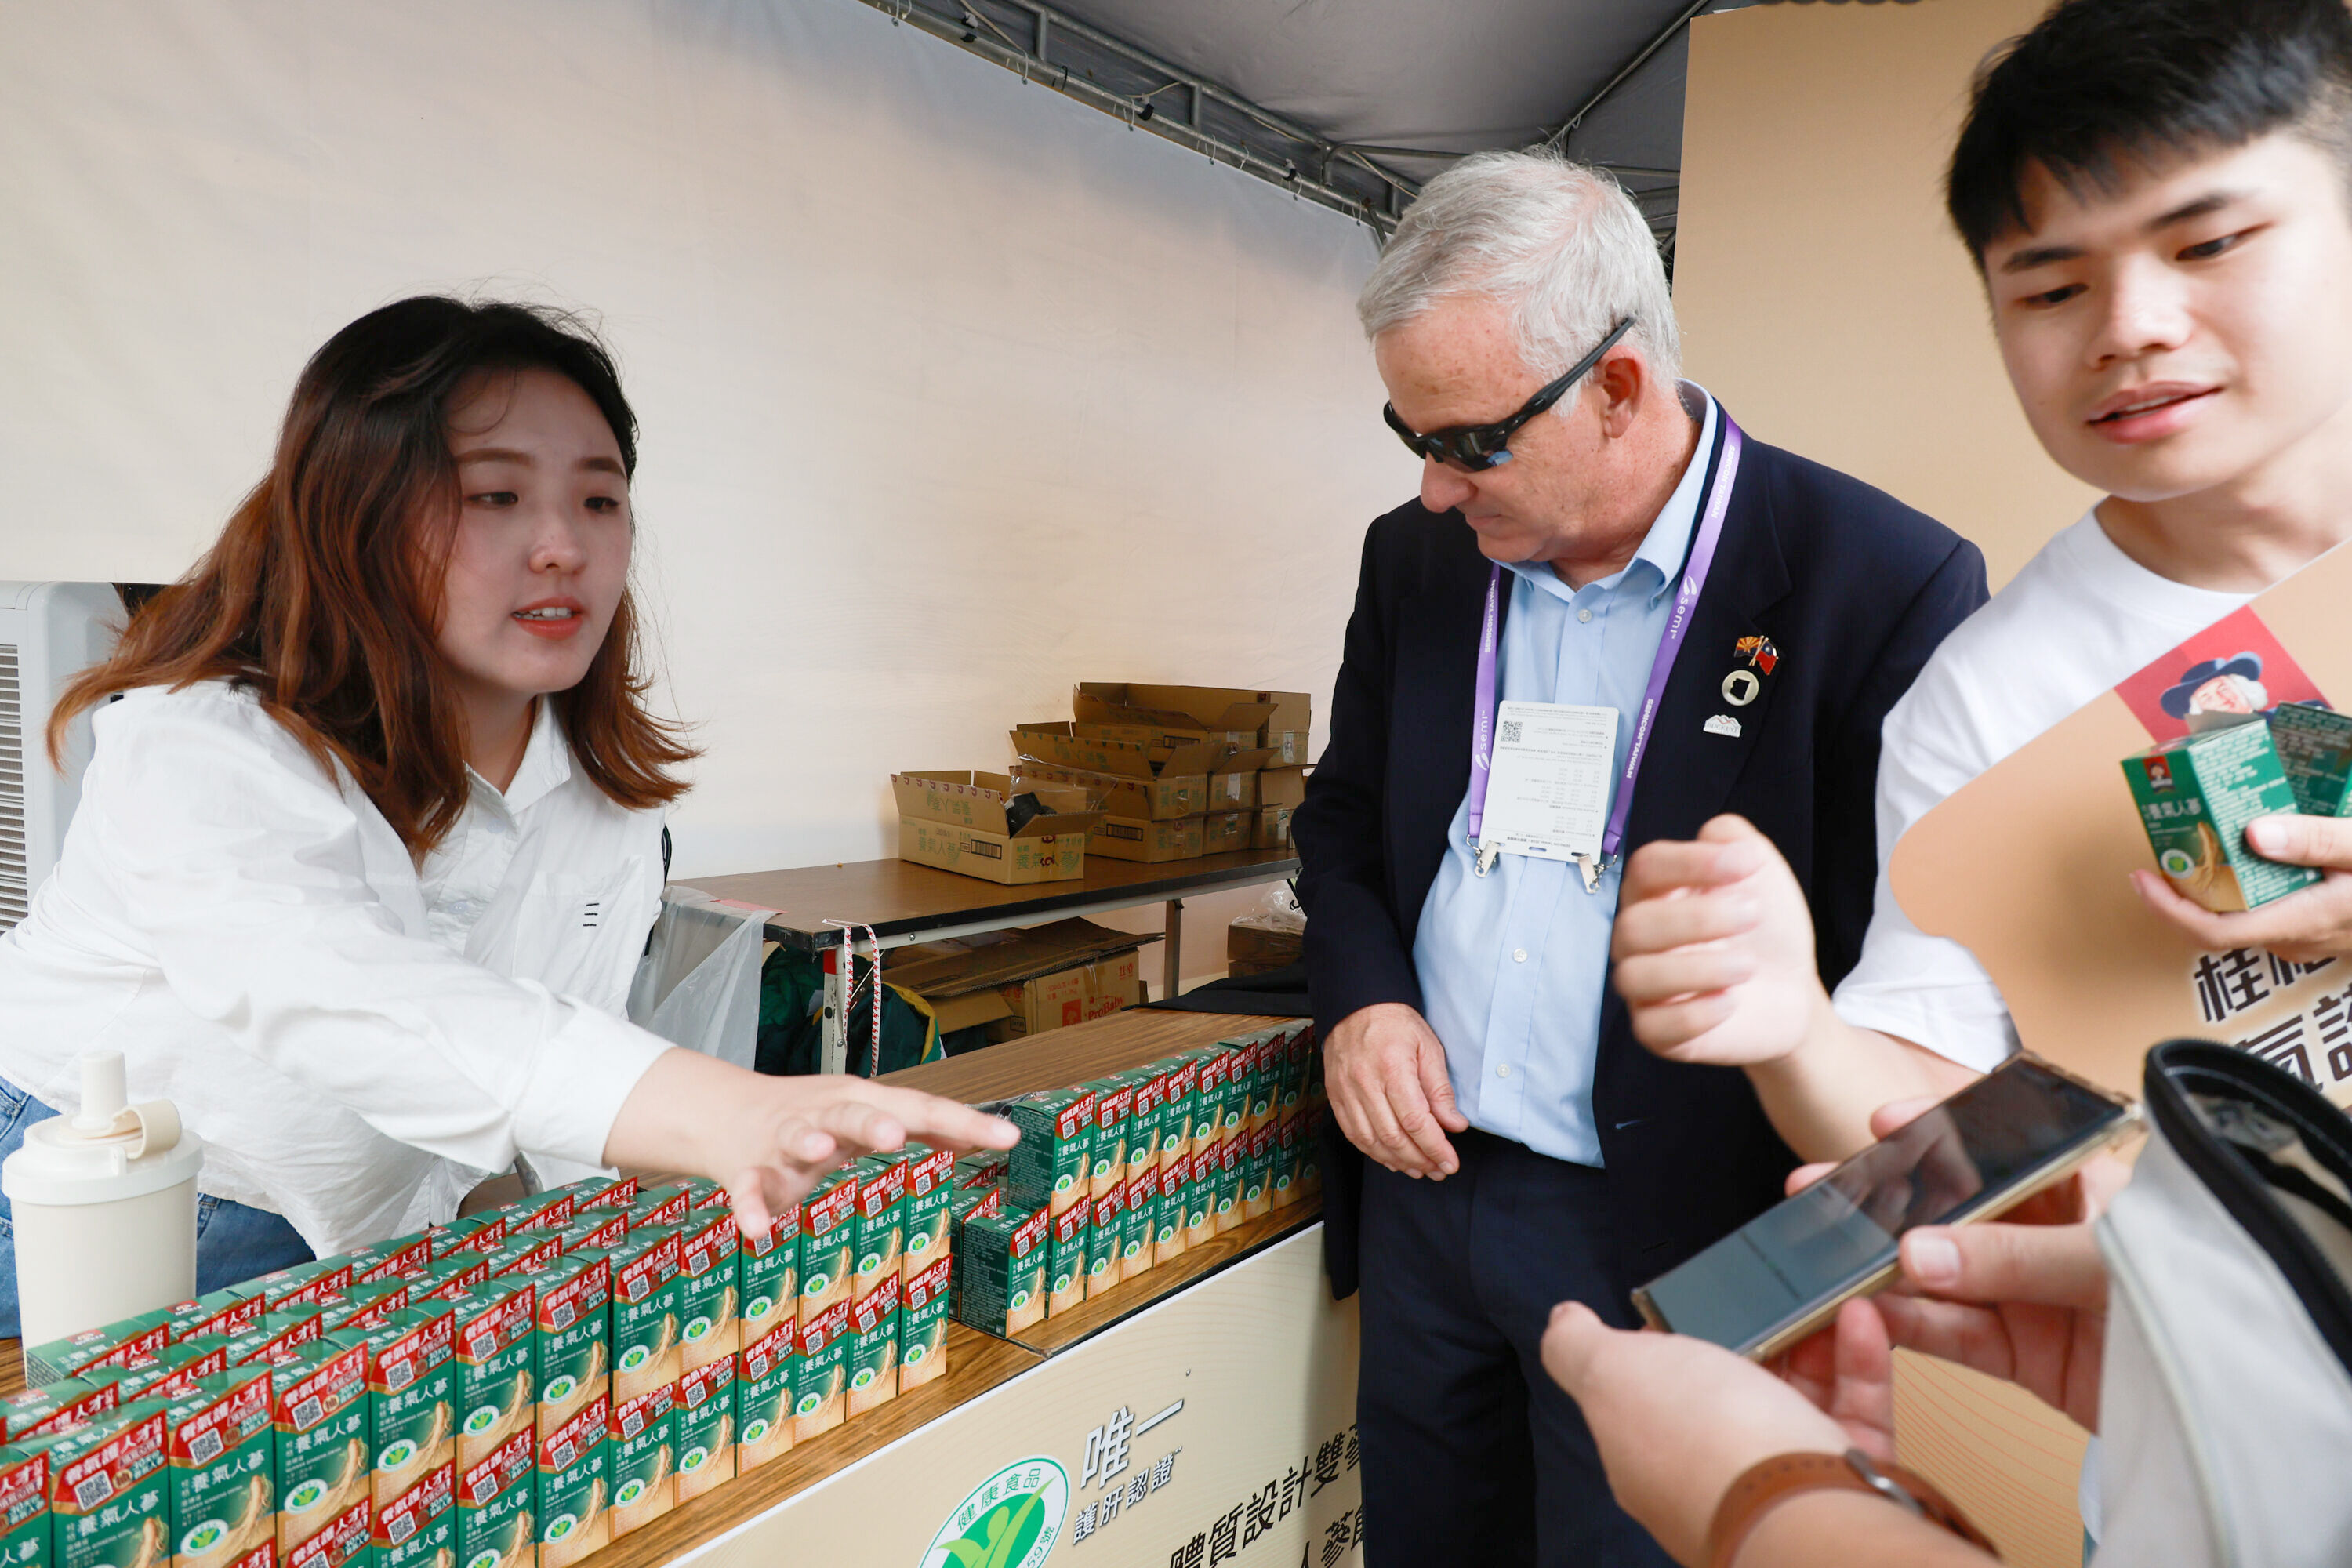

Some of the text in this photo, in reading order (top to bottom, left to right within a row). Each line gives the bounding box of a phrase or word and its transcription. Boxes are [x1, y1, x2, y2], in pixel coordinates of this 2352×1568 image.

[1711, 445, 1736, 518] SEMICON TAIWAN
[1626, 699, 1653, 779] SEMICON TAIWAN
[1080, 1399, 1184, 1489] 唯一
[957, 1468, 1041, 1531] 健康食品
[1073, 1452, 1175, 1545] 護肝認證
